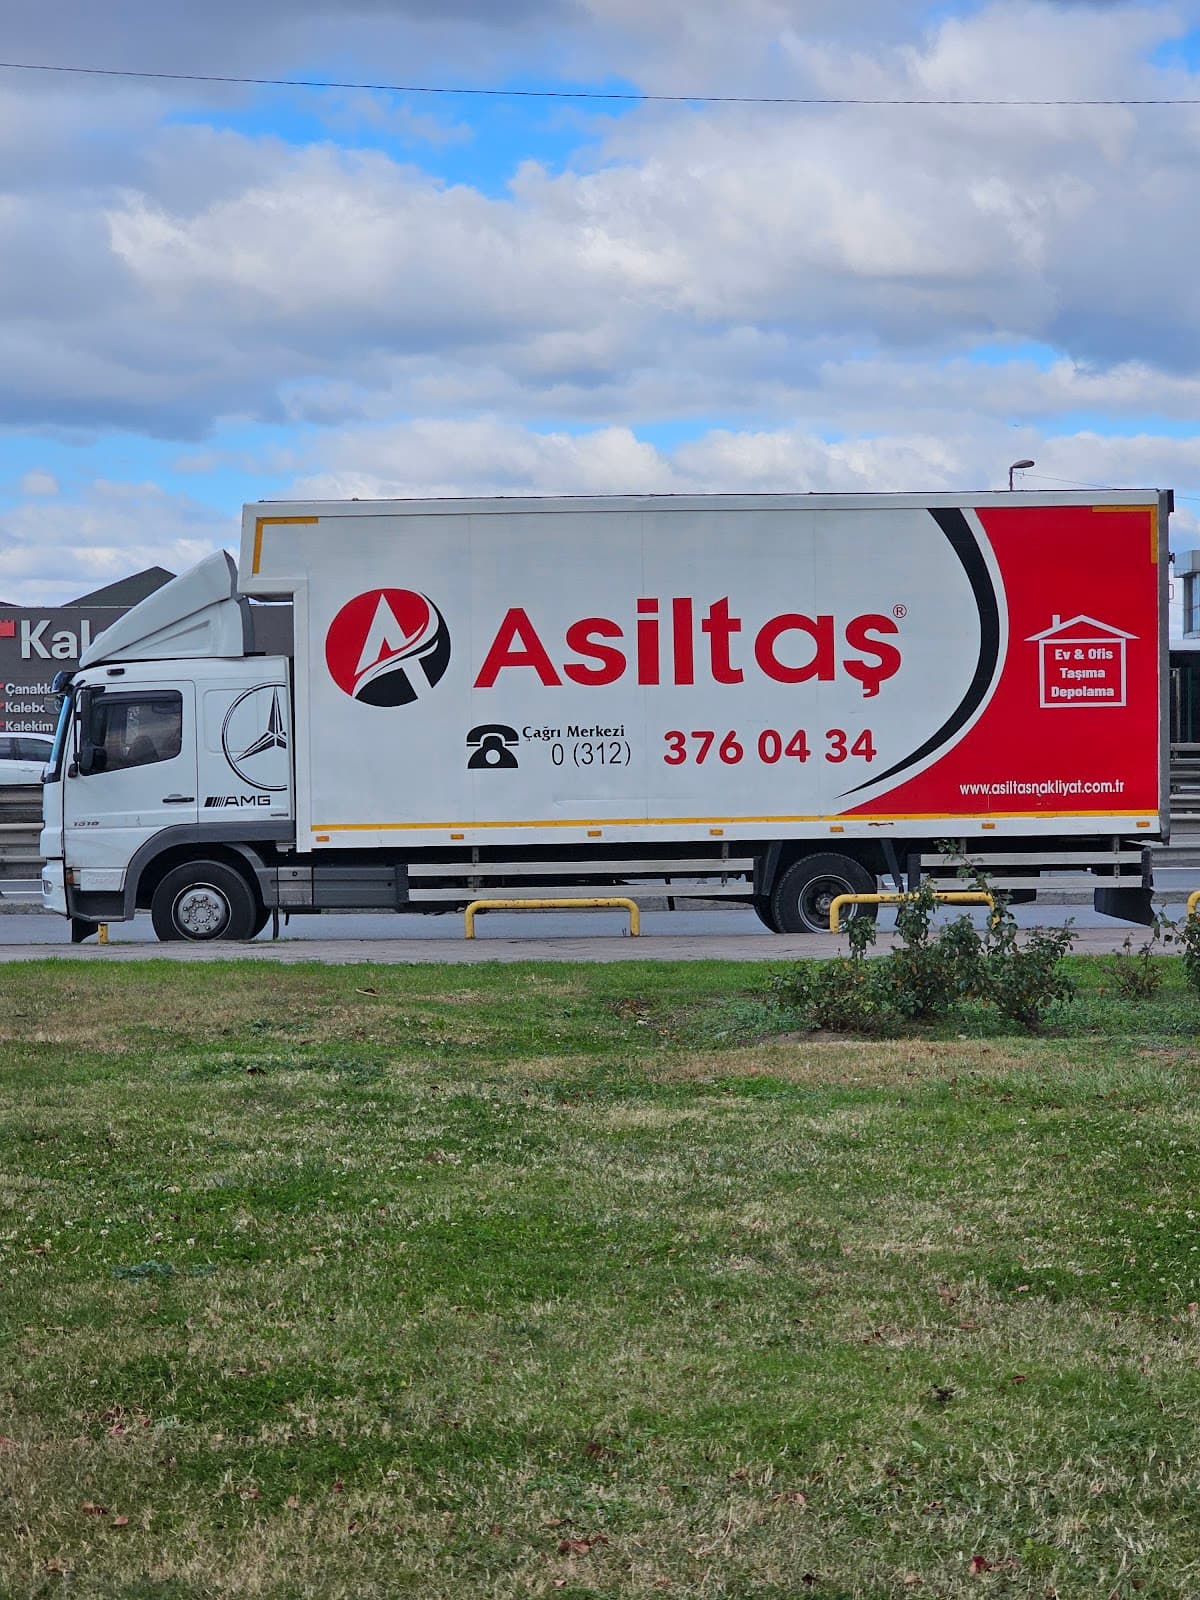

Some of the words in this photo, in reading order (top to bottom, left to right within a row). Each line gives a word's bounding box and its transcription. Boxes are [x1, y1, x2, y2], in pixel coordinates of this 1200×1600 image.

[20, 619, 104, 659] Kal
[474, 596, 902, 698] Asiltaş
[1055, 648, 1071, 660] Ev
[1074, 648, 1085, 660] &
[1088, 647, 1114, 660] Ofis
[1059, 667, 1106, 681] Taşıma
[1051, 685, 1115, 700] Depolama
[5, 720, 54, 732] Kalekim
[522, 726, 561, 742] Çağrı
[566, 724, 625, 738] Merkezi
[551, 743, 564, 766] 0
[573, 740, 631, 768] (312)
[664, 730, 744, 765] 376
[758, 729, 811, 764] 04
[825, 729, 877, 763] 34
[959, 779, 1125, 798] www.asiltasnakliyat.com.tr
[224, 794, 271, 808] AMG
